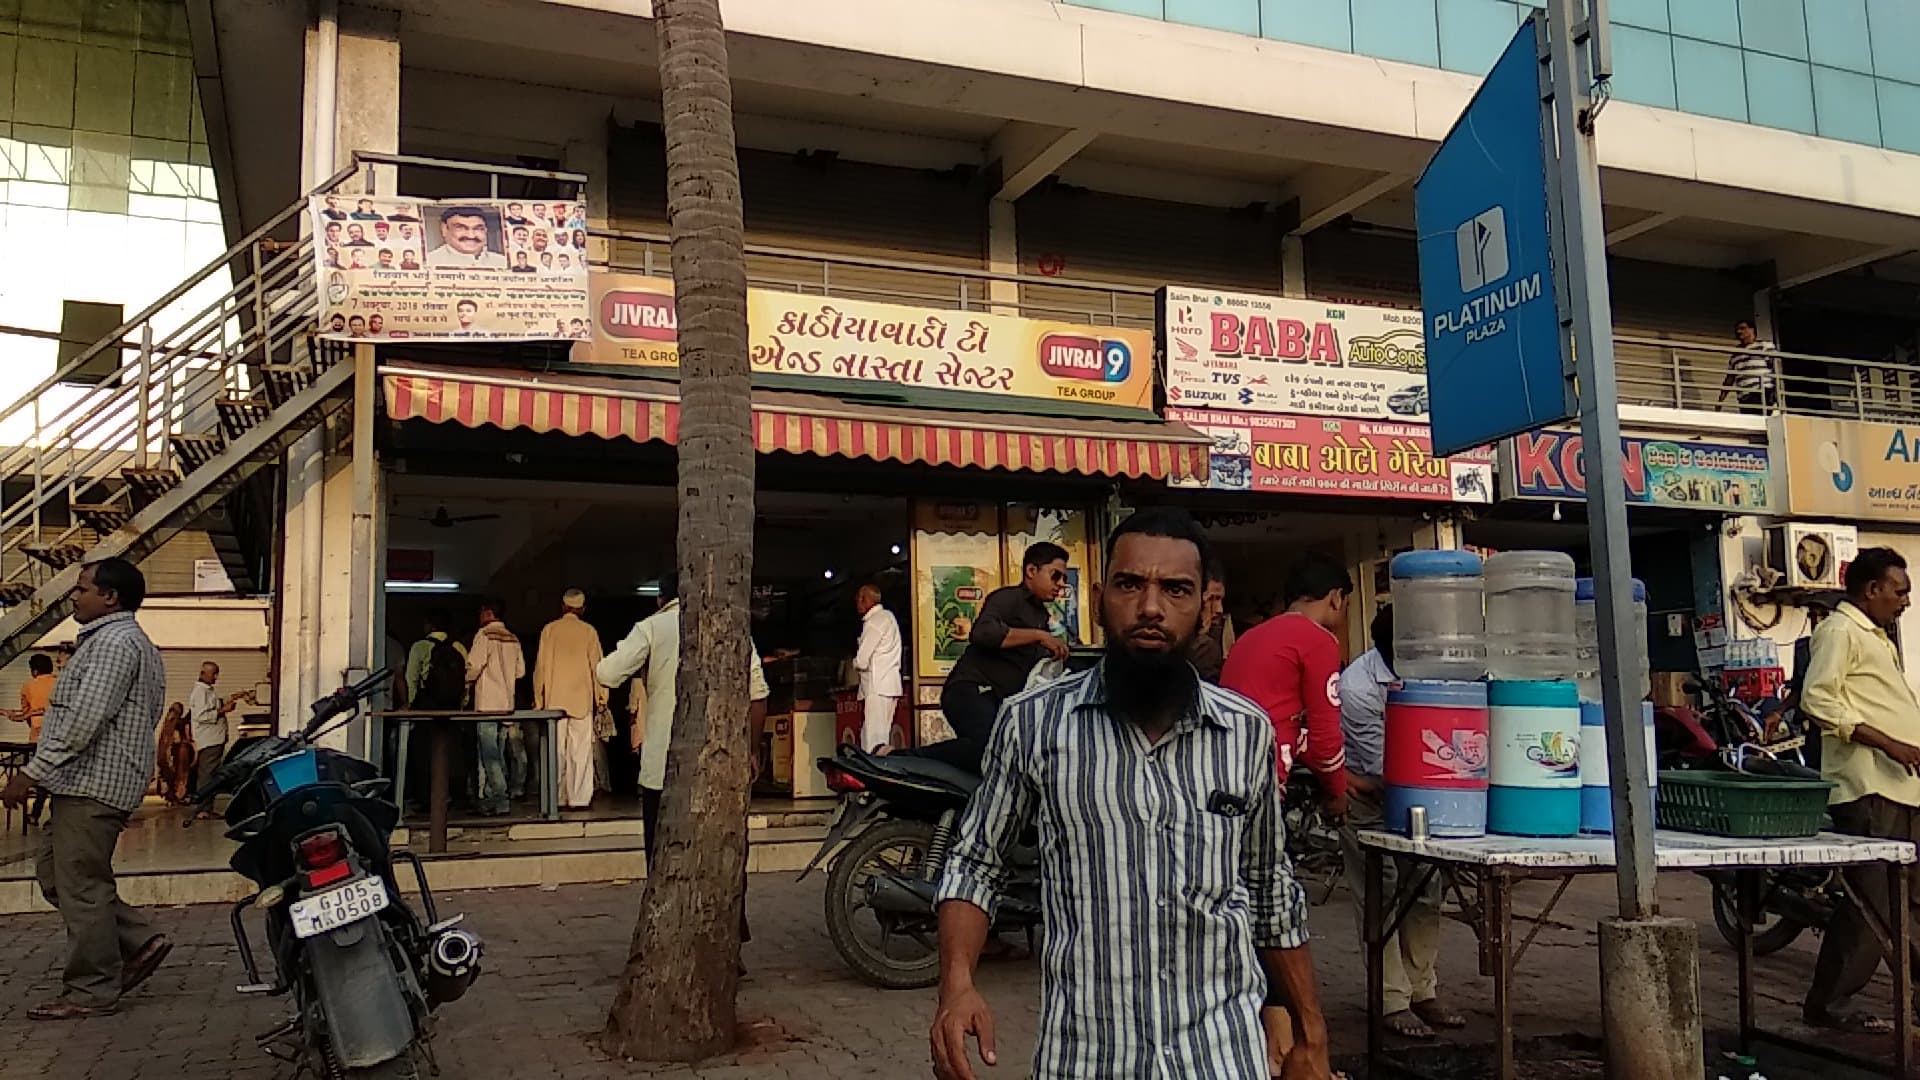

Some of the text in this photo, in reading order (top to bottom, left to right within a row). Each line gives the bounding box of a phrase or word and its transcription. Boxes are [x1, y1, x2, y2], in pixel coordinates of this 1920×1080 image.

[1434, 272, 1541, 339] PLATINUM
[1210, 311, 1340, 364] BABA
[1466, 318, 1506, 345] PLAZA
[621, 348, 678, 362] TEA GRO
[1048, 346, 1124, 376] JIVRAJ 9
[1349, 341, 1425, 367] AutoCons
[1211, 371, 1241, 385] TVS
[1056, 386, 1116, 400] TEA GROUP
[1184, 389, 1227, 401] SUZUKI
[1252, 441, 1311, 471] बाबा
[1320, 435, 1379, 475] ओटो
[319, 884, 367, 911] GJ05
